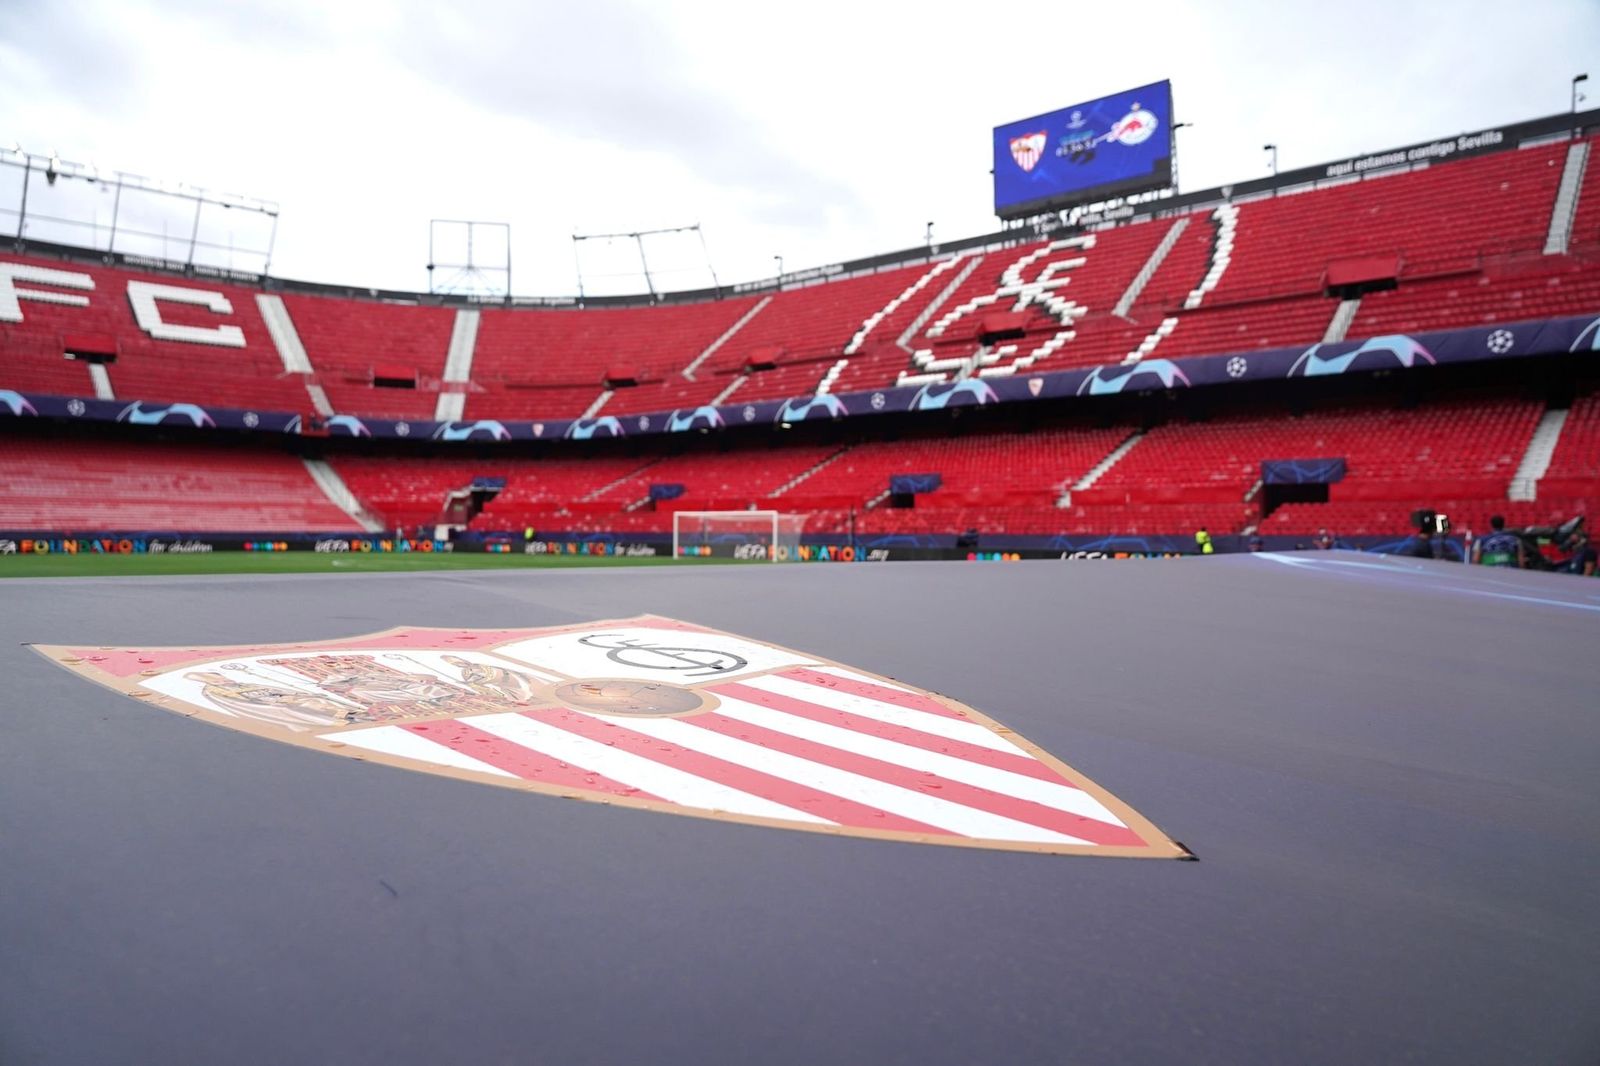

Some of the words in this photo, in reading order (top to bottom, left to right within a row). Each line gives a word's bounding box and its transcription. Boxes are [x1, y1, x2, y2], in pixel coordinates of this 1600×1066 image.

[1354, 151, 1407, 171] estamos
[1408, 140, 1456, 161] contigo
[1457, 130, 1503, 150] Sevilla
[20, 539, 146, 554] FOUNDATION
[314, 539, 350, 553] UEFA
[734, 543, 767, 560] UEFA
